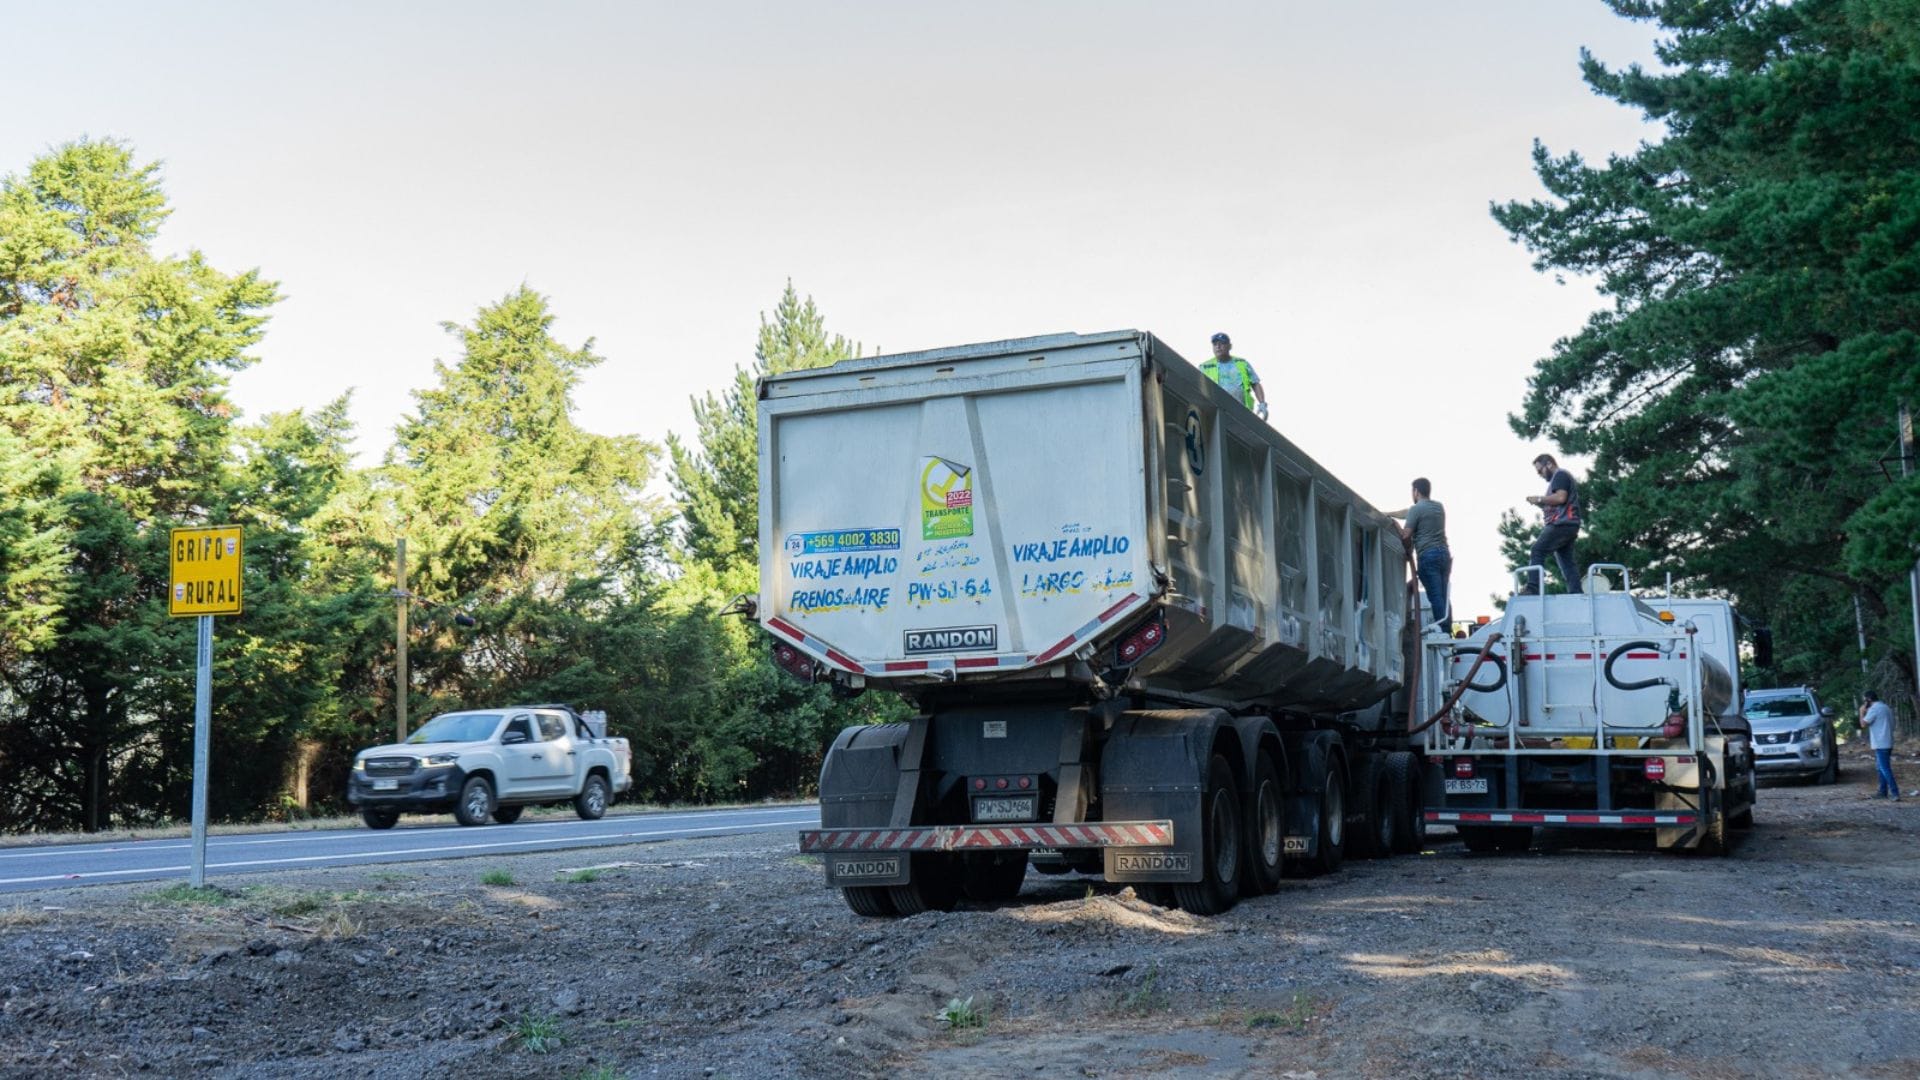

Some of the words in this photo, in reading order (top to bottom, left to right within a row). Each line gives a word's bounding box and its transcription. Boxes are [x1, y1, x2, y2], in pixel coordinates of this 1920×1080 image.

[947, 490, 972, 501] 2022
[925, 507, 969, 518] TRANSPORTE
[792, 541, 800, 549] 24
[808, 534, 835, 548] +569
[838, 532, 866, 546] 4002
[869, 530, 899, 545] 3830
[176, 536, 223, 562] GRIFO
[1013, 539, 1067, 563] VIRAJE
[1068, 534, 1130, 560] AMPLIO
[790, 558, 842, 580] VIRAJE
[842, 554, 898, 580] AMPLIO
[186, 579, 235, 605] RURAL
[790, 588, 844, 611] FRENOS
[851, 586, 890, 609] AIRE
[908, 630, 992, 649] RANDON
[837, 861, 896, 875] RANDON
[1119, 857, 1187, 869] RANDON
